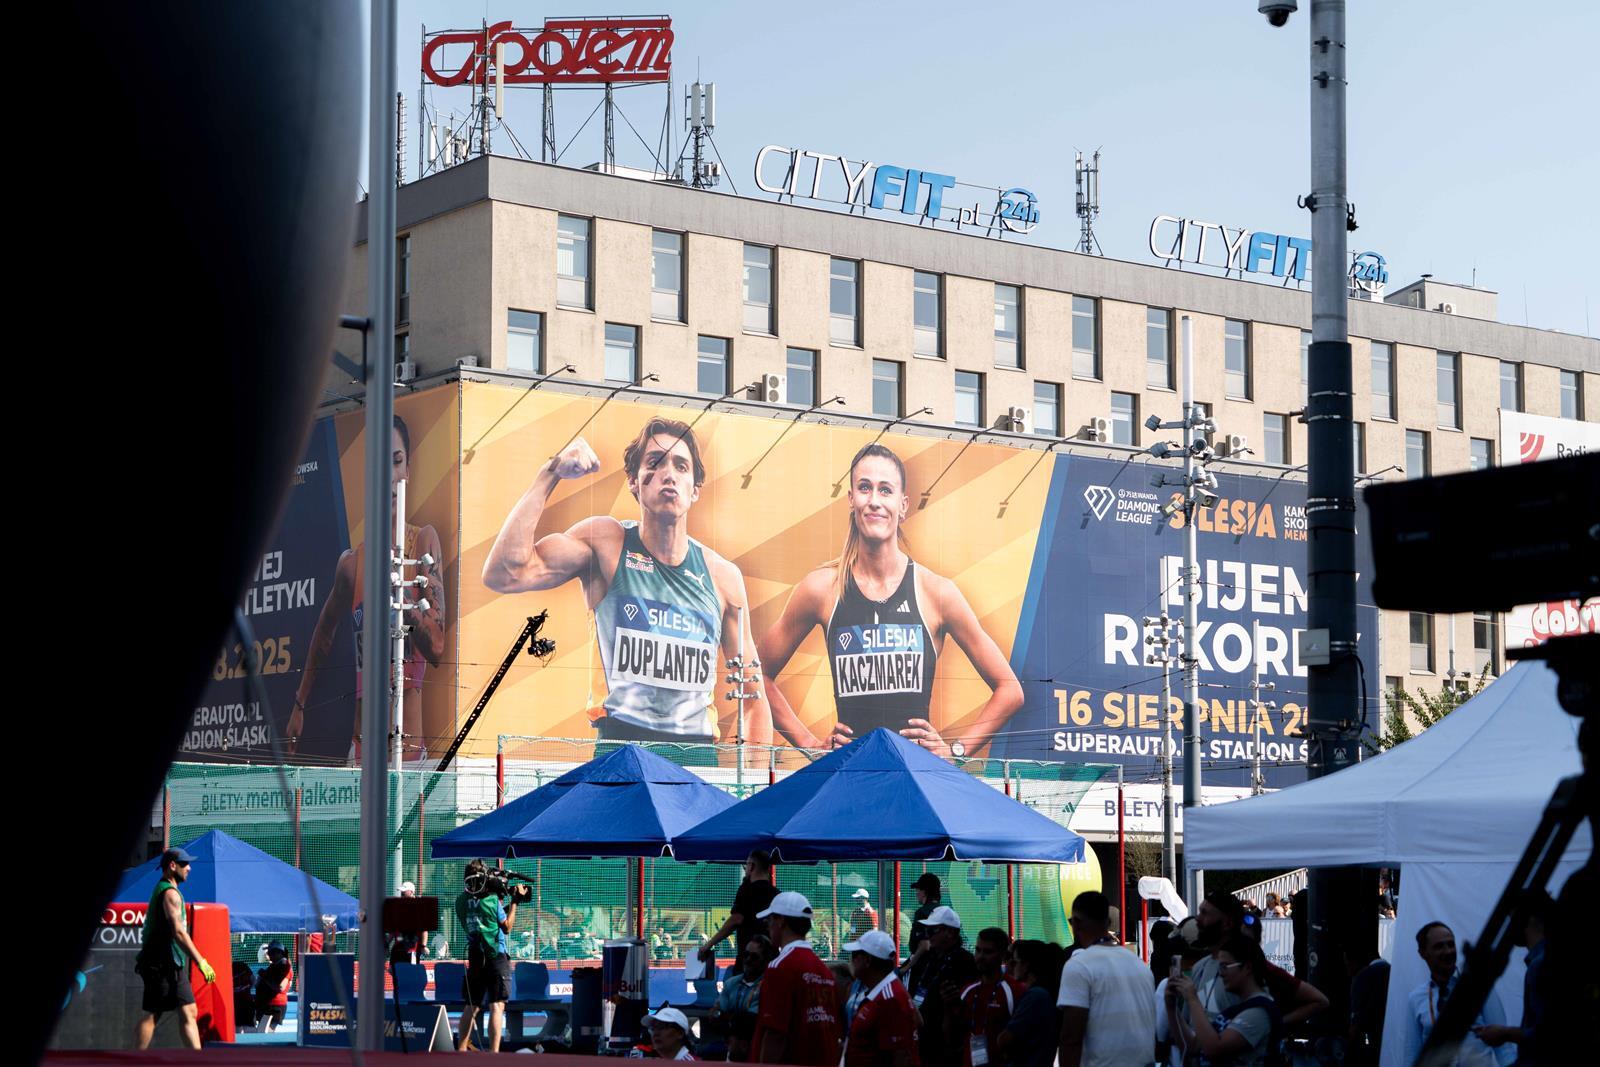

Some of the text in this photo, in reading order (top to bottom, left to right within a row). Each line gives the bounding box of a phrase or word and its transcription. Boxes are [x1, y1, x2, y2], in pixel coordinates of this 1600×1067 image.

[1115, 511, 1153, 525] LEAGUE
[648, 608, 707, 635] SILESIA
[862, 628, 919, 649] SILESIA
[618, 635, 710, 685] DUPLANTIS
[838, 653, 921, 694] KACZMAREK
[1054, 689, 1093, 726] 16
[1104, 800, 1163, 817] BLETY
